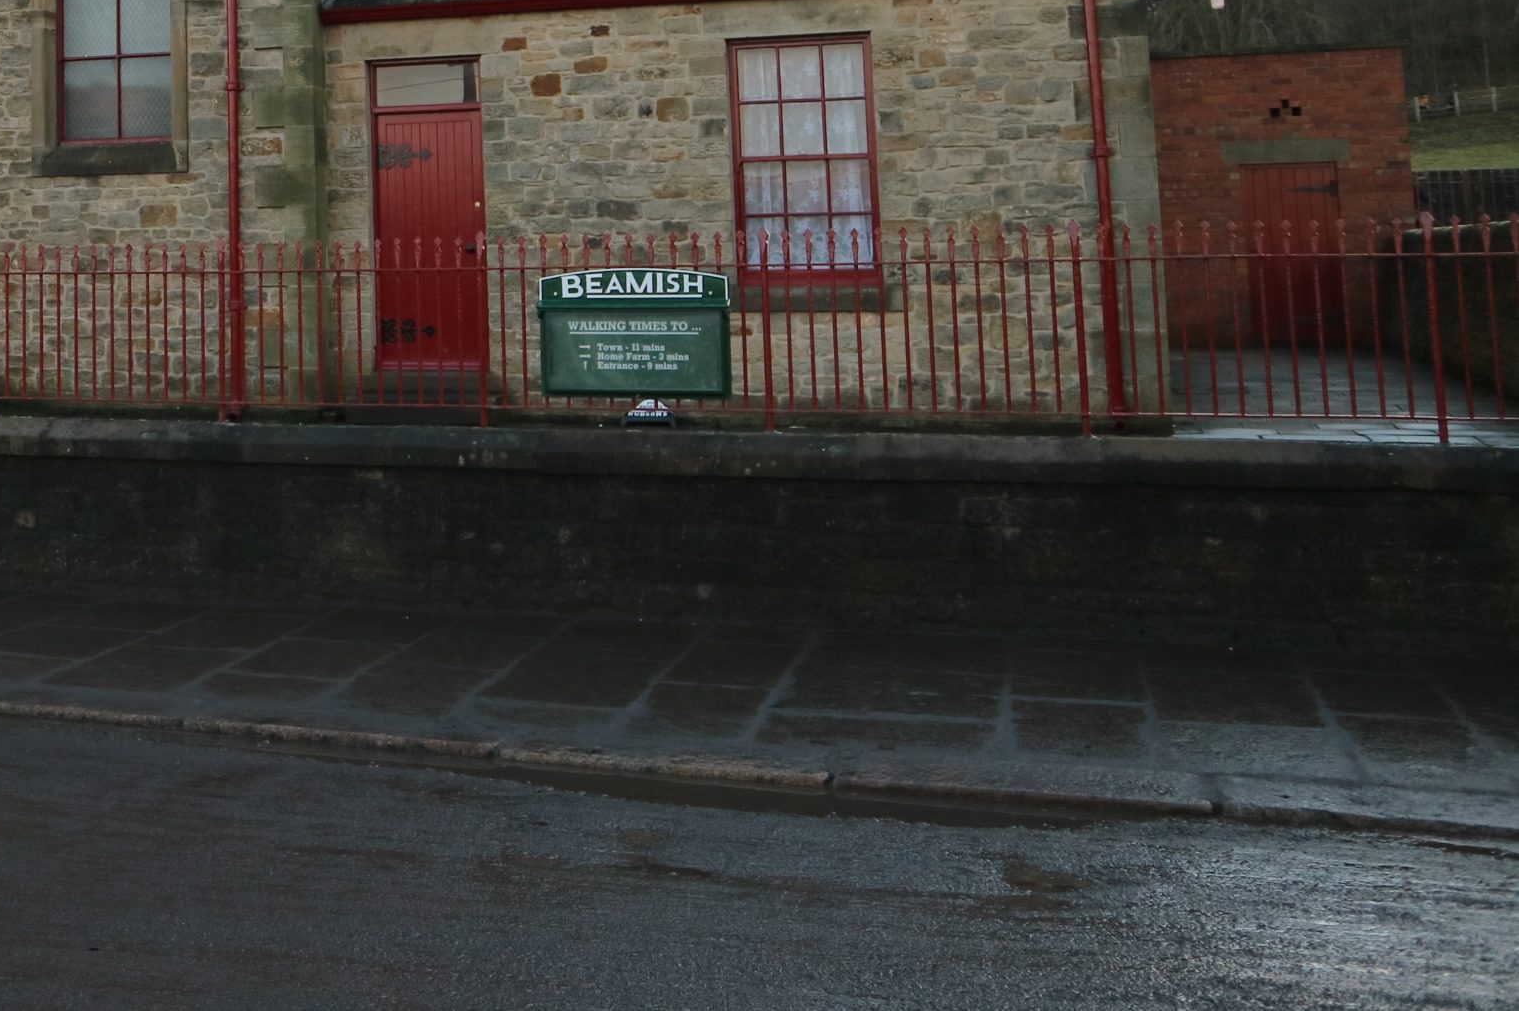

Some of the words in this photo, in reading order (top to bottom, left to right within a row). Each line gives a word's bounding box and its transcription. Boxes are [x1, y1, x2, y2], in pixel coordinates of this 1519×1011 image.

[561, 272, 703, 298] BEAMISH
[568, 321, 626, 331] WALKING
[629, 321, 667, 331] TIMES
[670, 321, 688, 331] TO
[597, 343, 623, 351] Town
[632, 343, 640, 351] 11
[643, 343, 665, 351] mins
[597, 353, 624, 361] Home
[626, 353, 650, 361] Farm
[658, 353, 664, 361] 3
[666, 353, 689, 361] mins
[597, 362, 639, 370] Entrance
[647, 362, 653, 370] 9
[655, 362, 678, 370] mins
